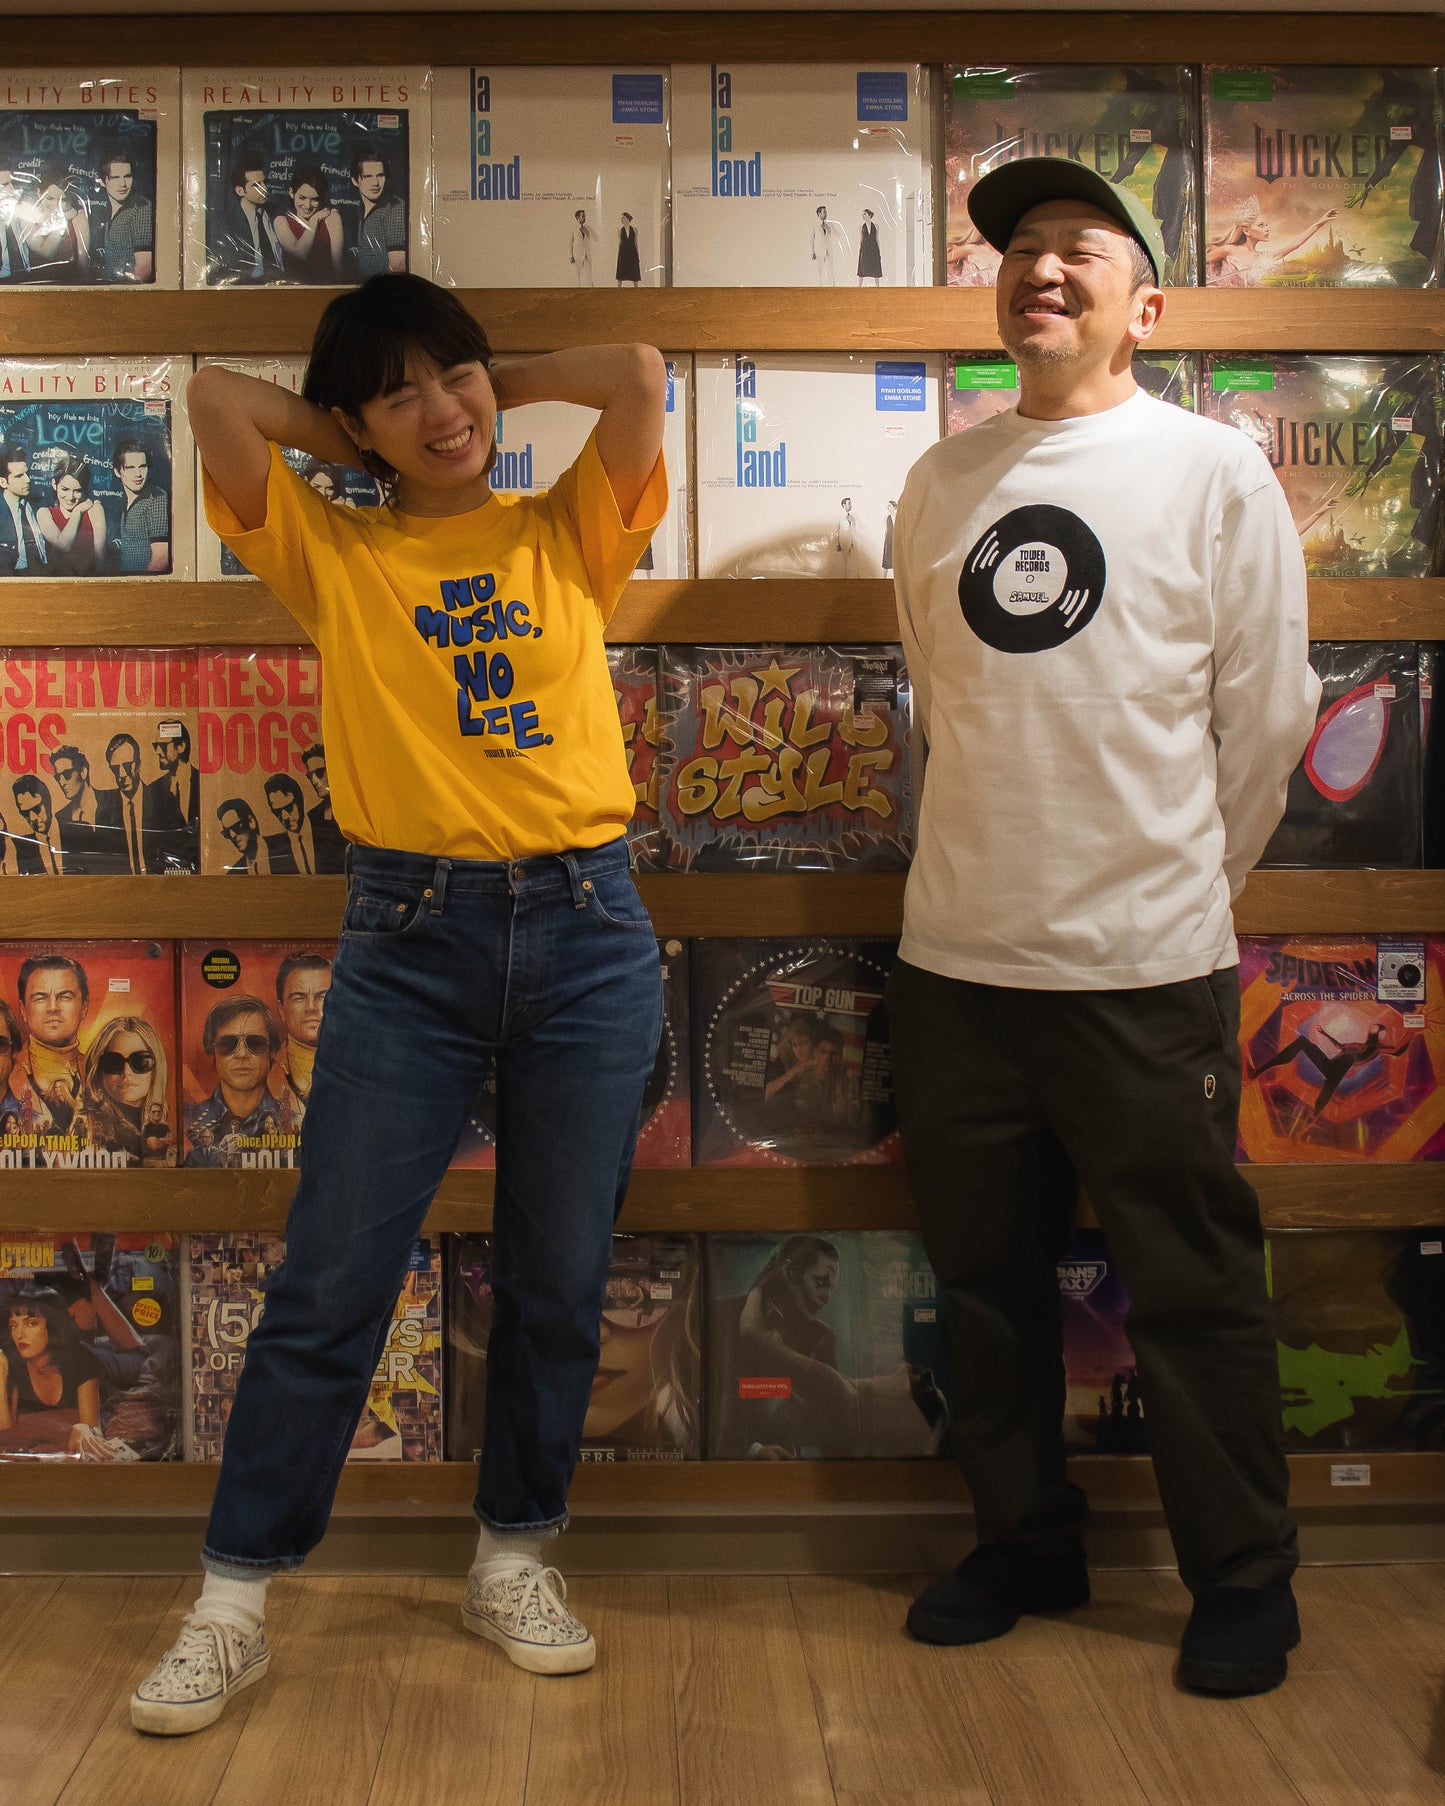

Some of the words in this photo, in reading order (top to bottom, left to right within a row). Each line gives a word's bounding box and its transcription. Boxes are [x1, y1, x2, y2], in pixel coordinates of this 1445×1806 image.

[81, 86, 157, 104] BITES
[203, 86, 315, 104] REALITY
[332, 85, 410, 103] BITES
[470, 68, 490, 112] la
[711, 64, 731, 109] la
[22, 124, 90, 156] Love
[273, 122, 342, 154] Love
[470, 112, 491, 156] la
[711, 108, 732, 153] la
[18, 156, 45, 170] credit
[269, 157, 297, 169] credit
[1254, 122, 1391, 184] WICKED
[68, 163, 100, 179] friends
[320, 163, 352, 178] friends
[471, 155, 521, 200] land
[712, 152, 761, 197] land
[95, 375, 172, 394] BITES
[735, 353, 756, 398] la
[36, 413, 103, 445] Love
[82, 453, 114, 469] friends
[490, 443, 532, 489] and
[737, 442, 787, 488] land
[1015, 561, 1050, 573] RECORDS
[1019, 550, 1046, 561] TOWER
[439, 573, 496, 612] NO
[1008, 590, 1050, 603] SAMUEL
[414, 600, 543, 649] MUSIC,
[0, 650, 199, 708] SERVOIR
[200, 649, 322, 708] RESE
[453, 651, 514, 702] NO
[457, 700, 554, 750] LEE.
[0, 713, 67, 774] GS
[200, 712, 320, 774] DOGS
[677, 747, 893, 822] STYLE
[795, 984, 823, 1007] TOP
[825, 989, 856, 1010] GUN
[1282, 992, 1316, 1001] ACROSS
[1320, 992, 1335, 1001] THE
[4, 1134, 38, 1148] UPON
[39, 1137, 46, 1146] A
[46, 1135, 79, 1151] TIME
[237, 1135, 260, 1148] ONCE
[262, 1134, 296, 1149] UPON
[0, 1241, 55, 1268] CTION
[133, 1307, 159, 1320] PRICE
[136, 1302, 160, 1313] SPECIAL
[209, 1353, 240, 1371] OF
